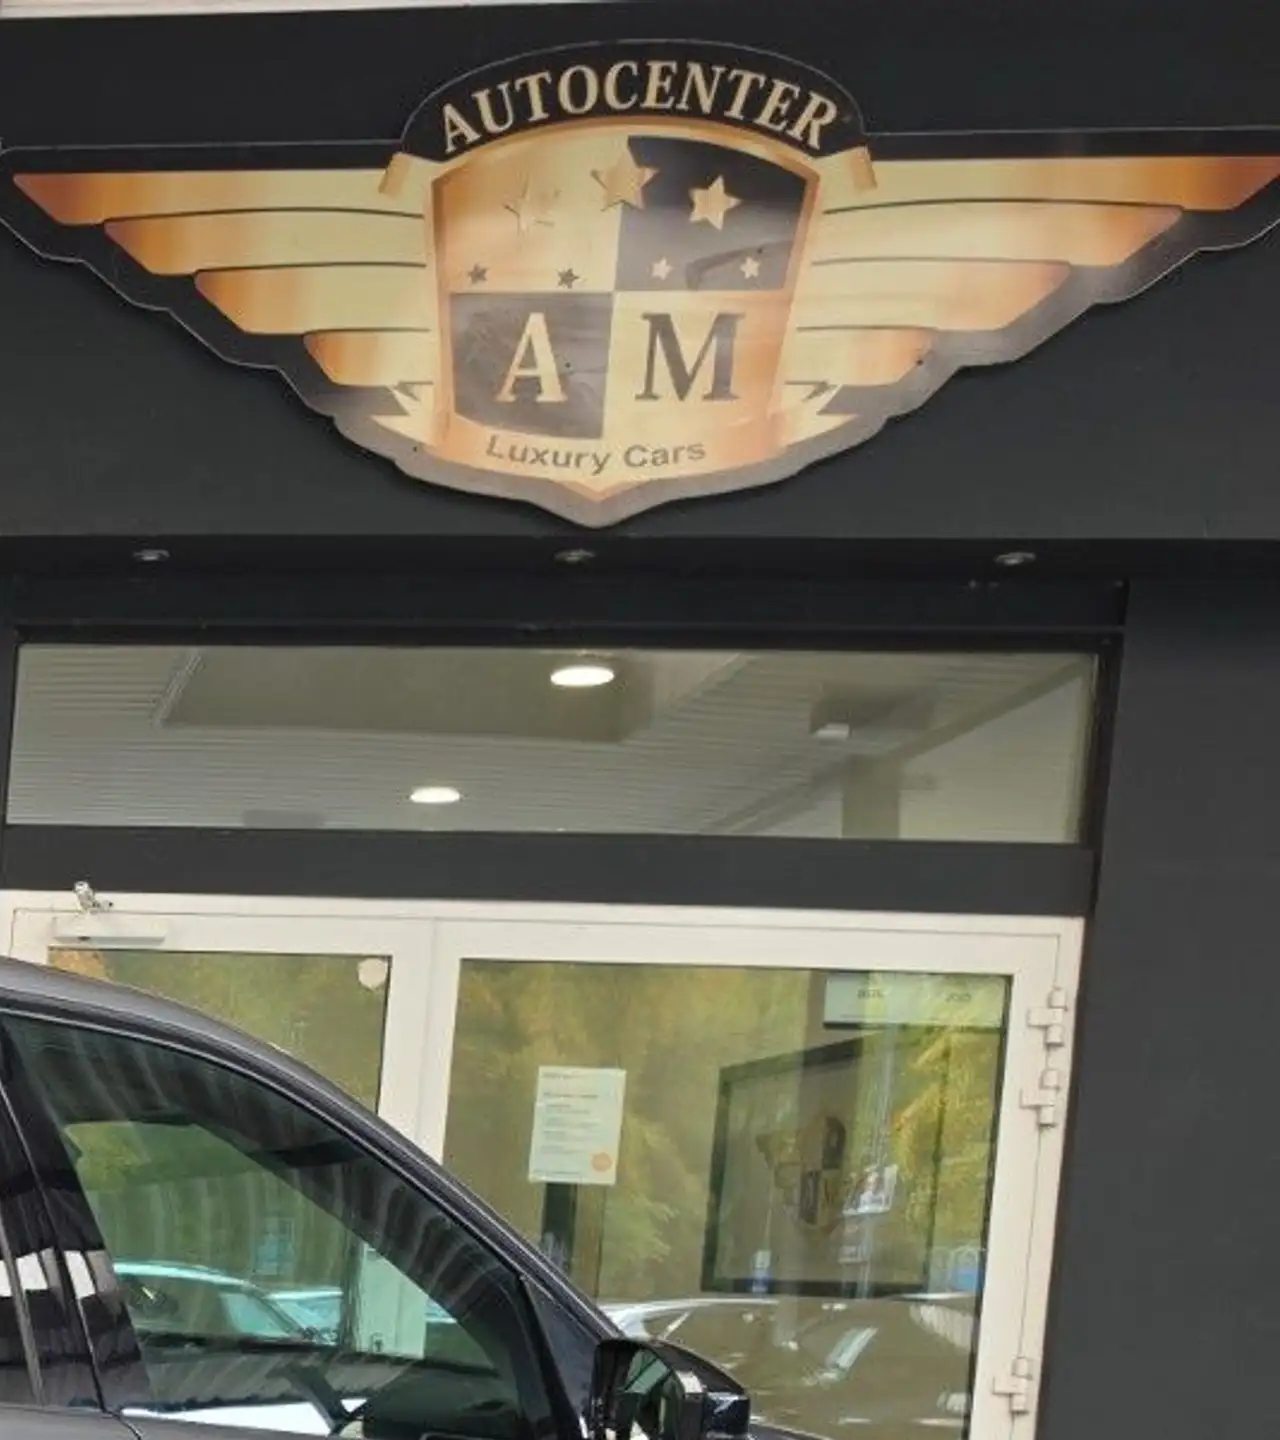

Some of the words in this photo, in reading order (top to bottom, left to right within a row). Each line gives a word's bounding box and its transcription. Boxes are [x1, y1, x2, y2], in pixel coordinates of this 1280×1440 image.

[441, 60, 838, 154] AUTOCENTER
[496, 312, 568, 403] A
[635, 313, 746, 401] M
[485, 434, 611, 476] Luxury
[623, 443, 706, 468] Cars
